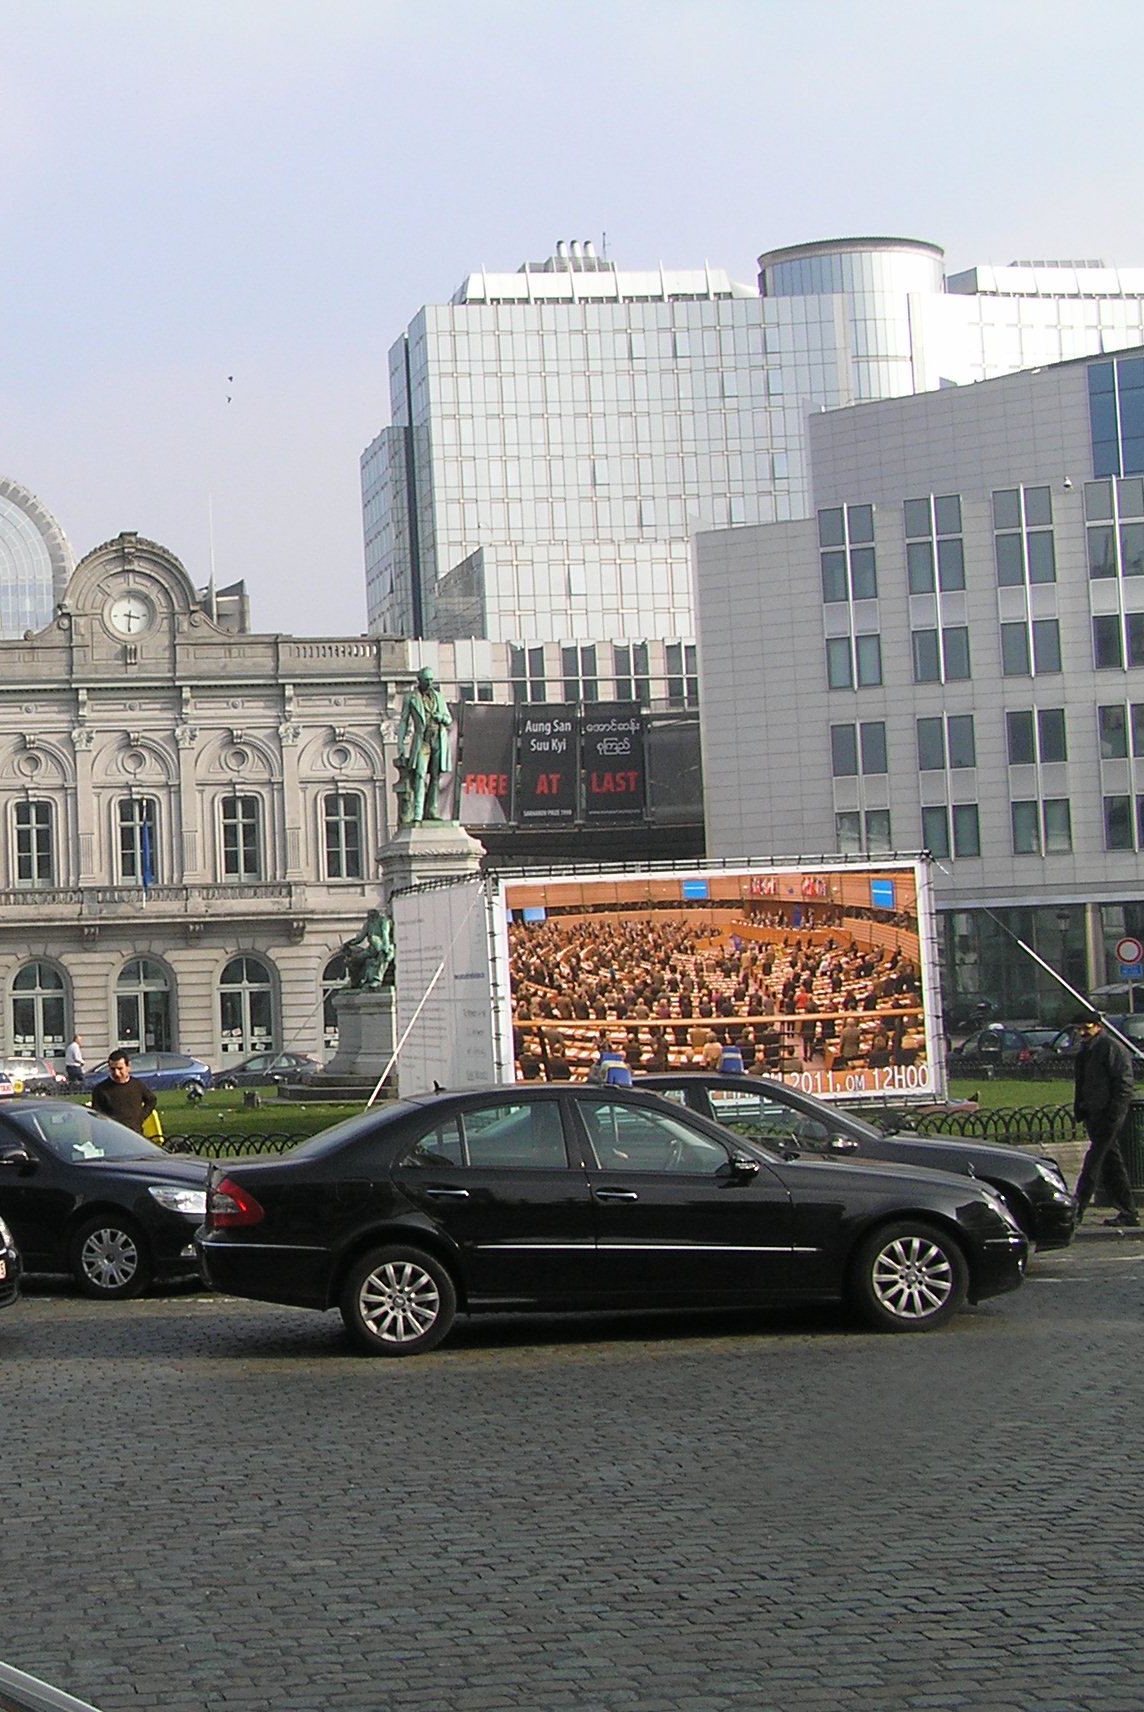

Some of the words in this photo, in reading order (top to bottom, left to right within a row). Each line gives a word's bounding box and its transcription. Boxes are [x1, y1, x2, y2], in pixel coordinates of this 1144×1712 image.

[525, 719, 551, 735] Aung
[553, 719, 572, 732] San
[530, 738, 550, 752] Suu
[551, 738, 567, 754] Kyi
[464, 773, 509, 795] FREE
[536, 773, 561, 794] AT
[591, 771, 639, 793] LAST
[845, 1074, 865, 1092] OM
[872, 1064, 929, 1090] 12H00
